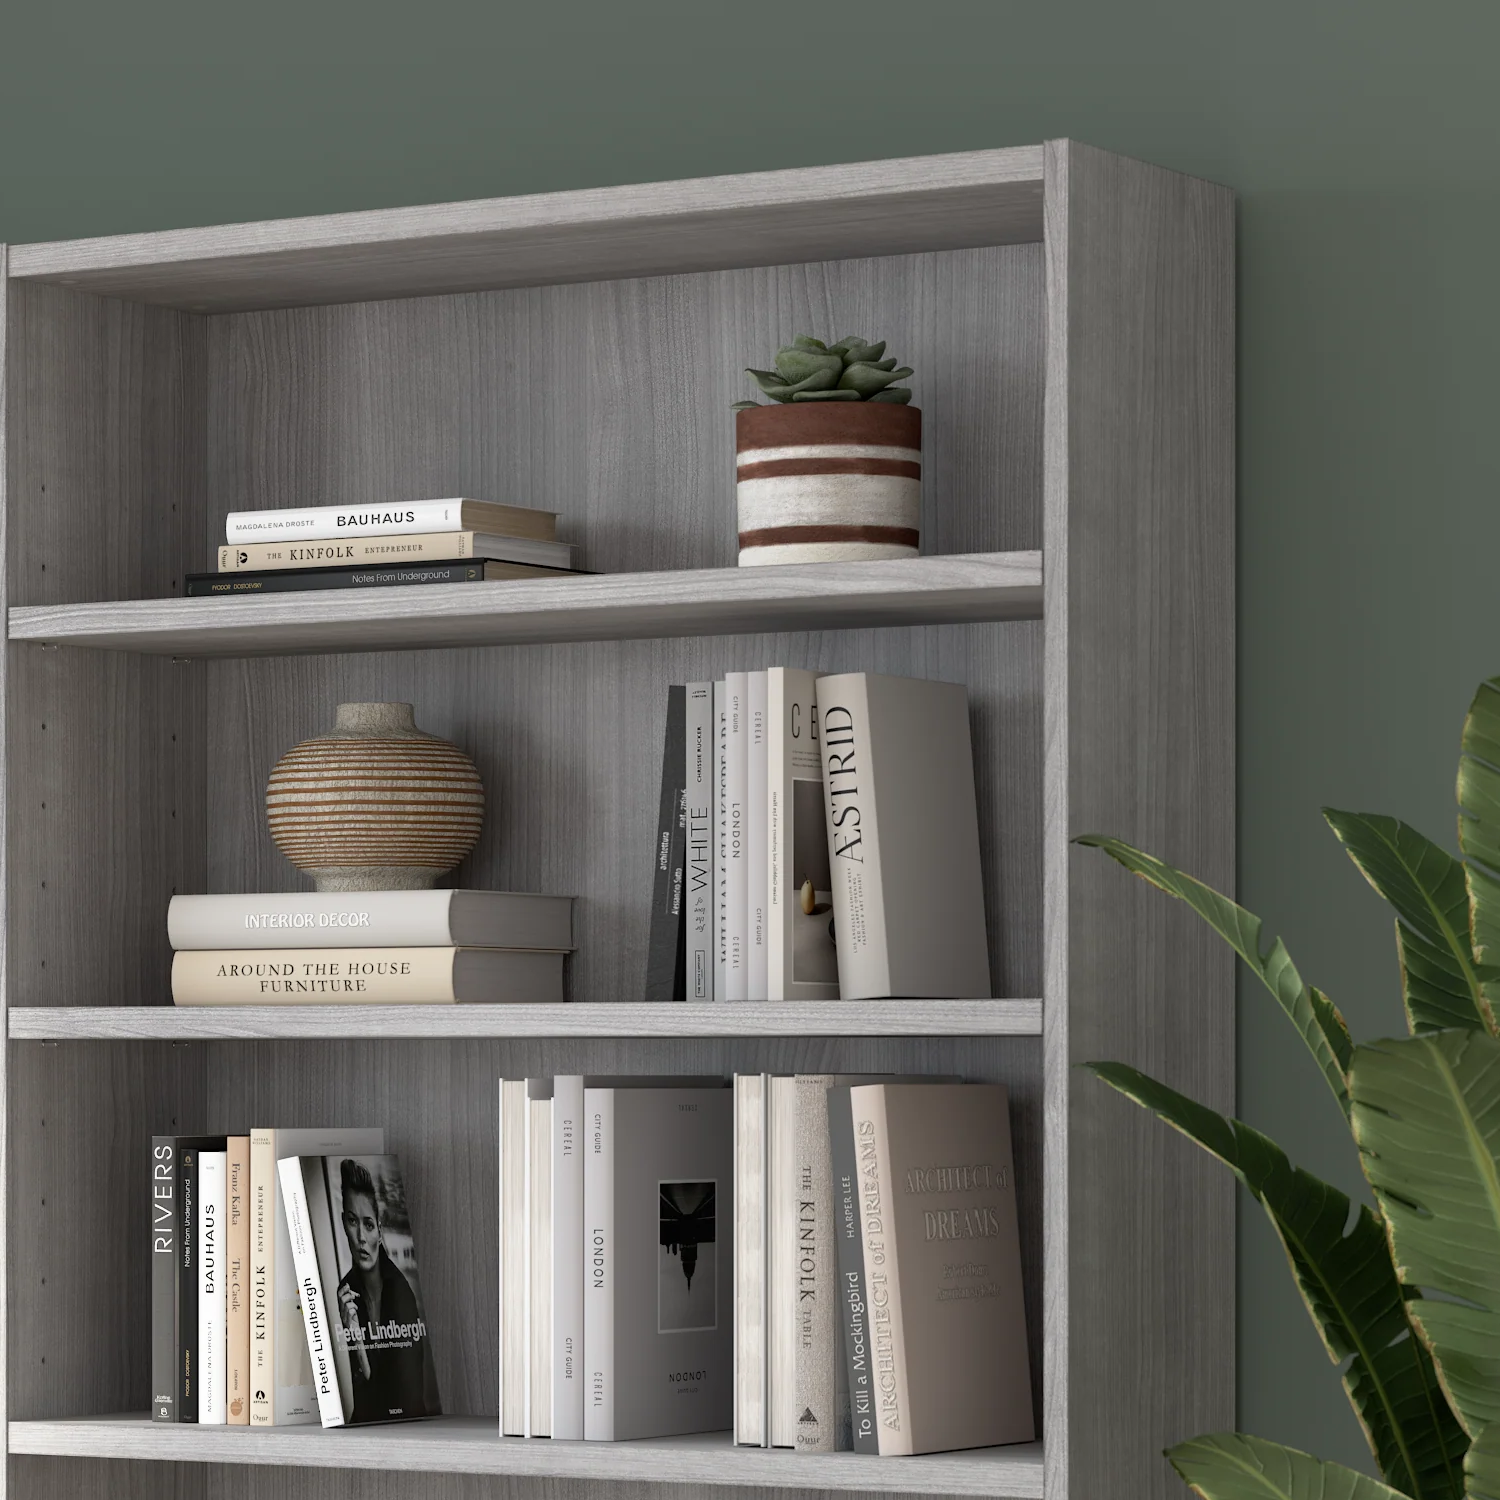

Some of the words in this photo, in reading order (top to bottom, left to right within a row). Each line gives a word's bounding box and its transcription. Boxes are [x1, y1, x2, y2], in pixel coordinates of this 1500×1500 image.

[236, 521, 283, 531] MAGDALENA
[285, 519, 315, 527] DROSTE
[337, 511, 415, 527] BAUHAUS
[267, 551, 282, 560] THE
[289, 547, 354, 561] KINFOLK
[365, 544, 423, 554] ENTEPRENEUR
[352, 573, 374, 583] Notes
[377, 572, 395, 582] From
[398, 569, 450, 582] Underground
[732, 803, 740, 859] LONDON
[660, 832, 669, 870] architettura
[691, 807, 707, 892] WHITE
[245, 913, 314, 929] INTERIOR
[319, 912, 370, 927] DECOR
[732, 936, 740, 969] CEREAL
[216, 964, 295, 977] AROUND
[303, 963, 339, 975] THE
[348, 962, 411, 975] HOUSE
[260, 979, 367, 993] FURNITURE
[232, 1163, 240, 1192] Franz
[859, 1120, 883, 1235] DREAMS
[905, 1166, 992, 1193] ARCHITECT
[996, 1168, 1009, 1189] of
[154, 1145, 172, 1253] RIVERS
[232, 1196, 240, 1225] Kafka
[924, 1207, 999, 1241] DREAMS
[205, 1204, 215, 1294] BAUHAUS
[593, 1228, 603, 1289] LONDON
[800, 1200, 815, 1302] KINFOLK
[874, 1242, 885, 1264] of
[232, 1258, 240, 1280] The
[232, 1282, 240, 1313] Castle
[303, 1278, 323, 1351] Lindbergh
[846, 1271, 863, 1371] Mockingbird
[335, 1323, 366, 1342] Peter
[368, 1318, 426, 1341] Lindbergh
[874, 1272, 900, 1432] ARCHITECT
[318, 1355, 331, 1394] Peter
[594, 1371, 602, 1407] CEREAL
[857, 1375, 866, 1384] a
[857, 1390, 869, 1413] Kill
[858, 1418, 871, 1439] To
